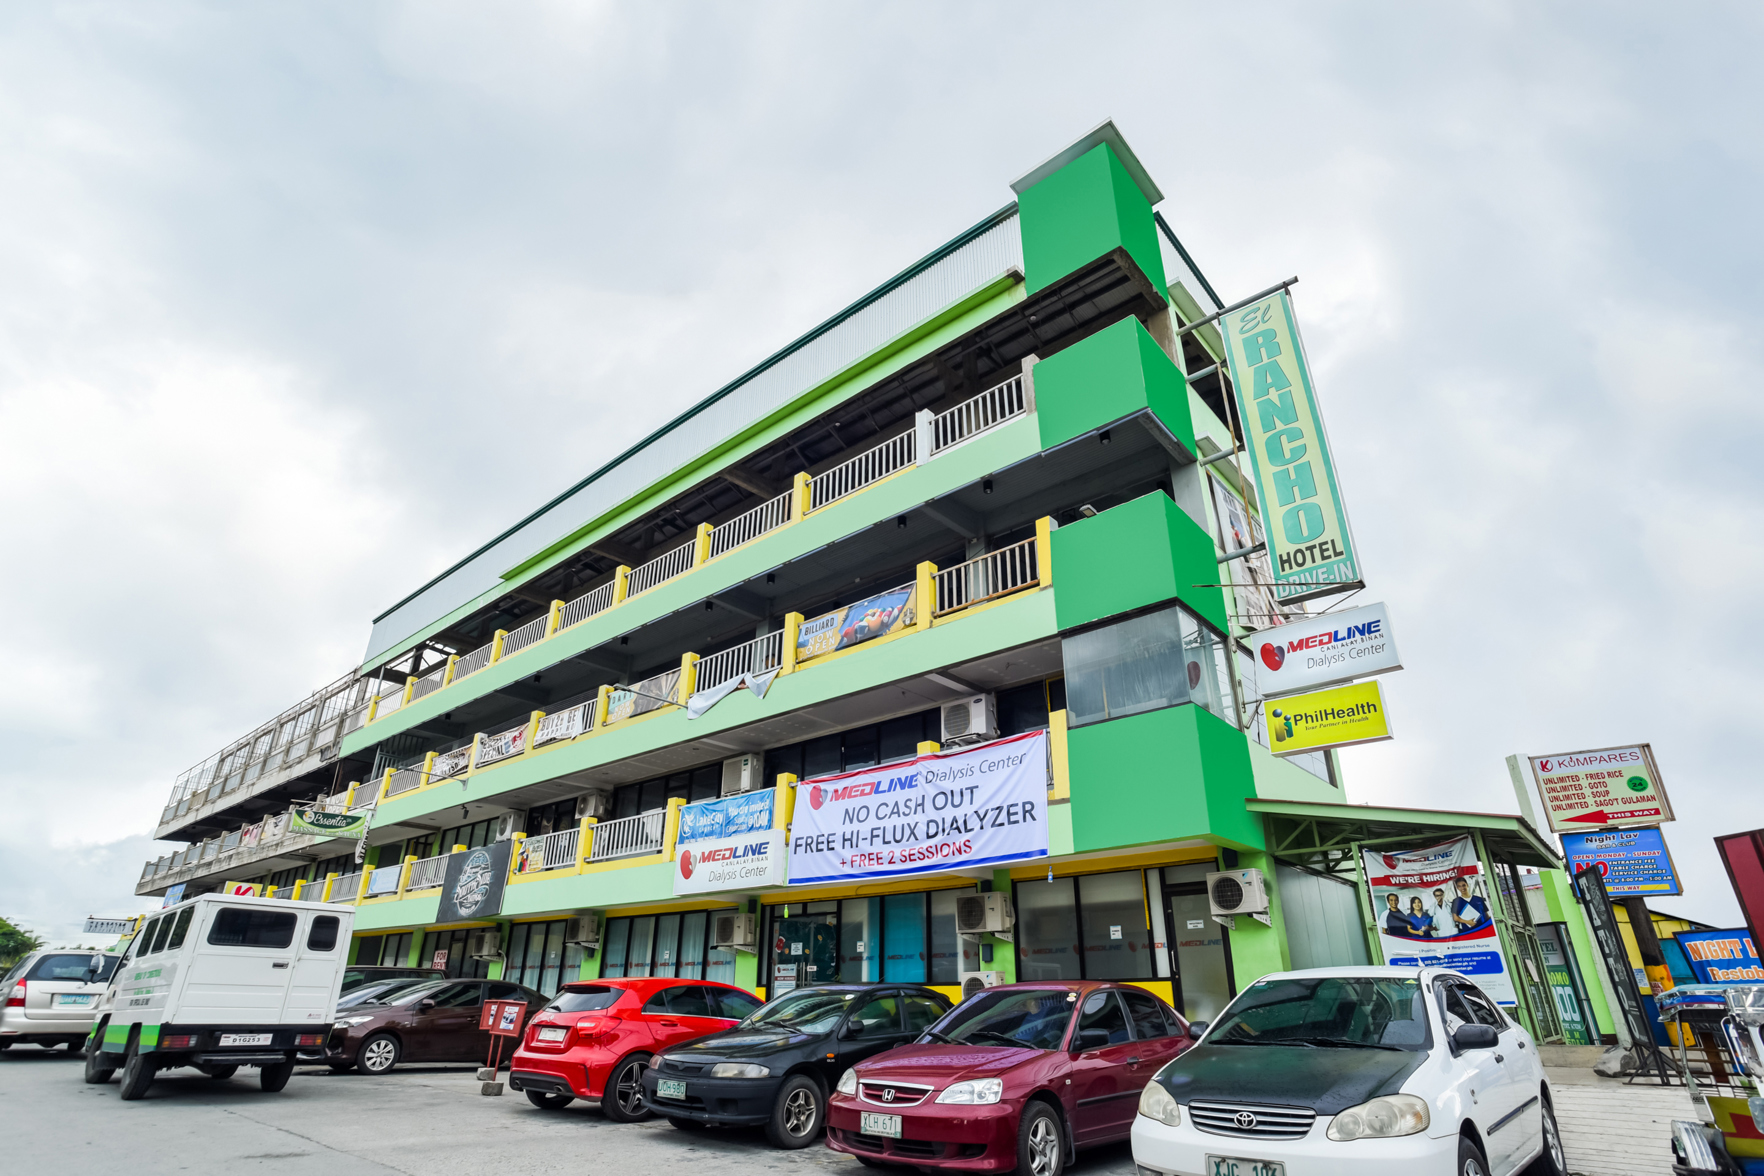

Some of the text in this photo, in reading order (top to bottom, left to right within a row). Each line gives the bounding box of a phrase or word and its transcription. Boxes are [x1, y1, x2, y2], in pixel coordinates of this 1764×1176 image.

[1239, 303, 1272, 335] El
[1242, 328, 1325, 544] RANCHO
[1278, 538, 1344, 573] HOTEL
[1277, 560, 1354, 599] DRIVE-IN
[804, 617, 834, 636] BILLIARD
[808, 628, 834, 646] NOW
[1286, 619, 1382, 654] MEDLINE
[805, 637, 835, 655] OPEN
[1307, 642, 1386, 669] Dialysis Center
[1293, 701, 1378, 726] PhilHealth
[1319, 721, 1341, 729] Partner
[830, 752, 1026, 803] MEDLINE Dialysis Center
[1543, 775, 1580, 785] UNLIMITED
[1585, 772, 1606, 781] FRIED
[1607, 770, 1624, 778] RICE
[1546, 783, 1583, 794] UNLIMITED
[1588, 781, 1608, 790] GOTO
[1548, 792, 1586, 803] UNLIMITED
[1591, 790, 1610, 799] SOUP
[842, 785, 979, 826] NO CASH OUT
[1551, 801, 1589, 811] UNLIMITED
[1621, 794, 1657, 805] GULAMAN
[314, 813, 347, 827] Essentia
[793, 800, 1037, 855] FREE HI-FLUX DIALYZER
[1585, 832, 1640, 844] Night Lav
[698, 842, 770, 864] MEDLINE
[840, 839, 973, 869] + FREE 2 SESSIONS
[1596, 852, 1627, 860] MONDAY
[708, 866, 768, 883] Dialysis Center
[1390, 869, 1458, 884] WE'RE HIRING!
[1032, 946, 1068, 955] MEDLINE
[1179, 938, 1223, 947] MEDLINE
[1685, 939, 1743, 962] NIGHT
[436, 951, 447, 960] FOR
[1578, 877, 1640, 1040] TATTOO
[433, 961, 446, 970] RENT
[673, 1084, 685, 1095] 980
[864, 1114, 897, 1131] XLH 671
